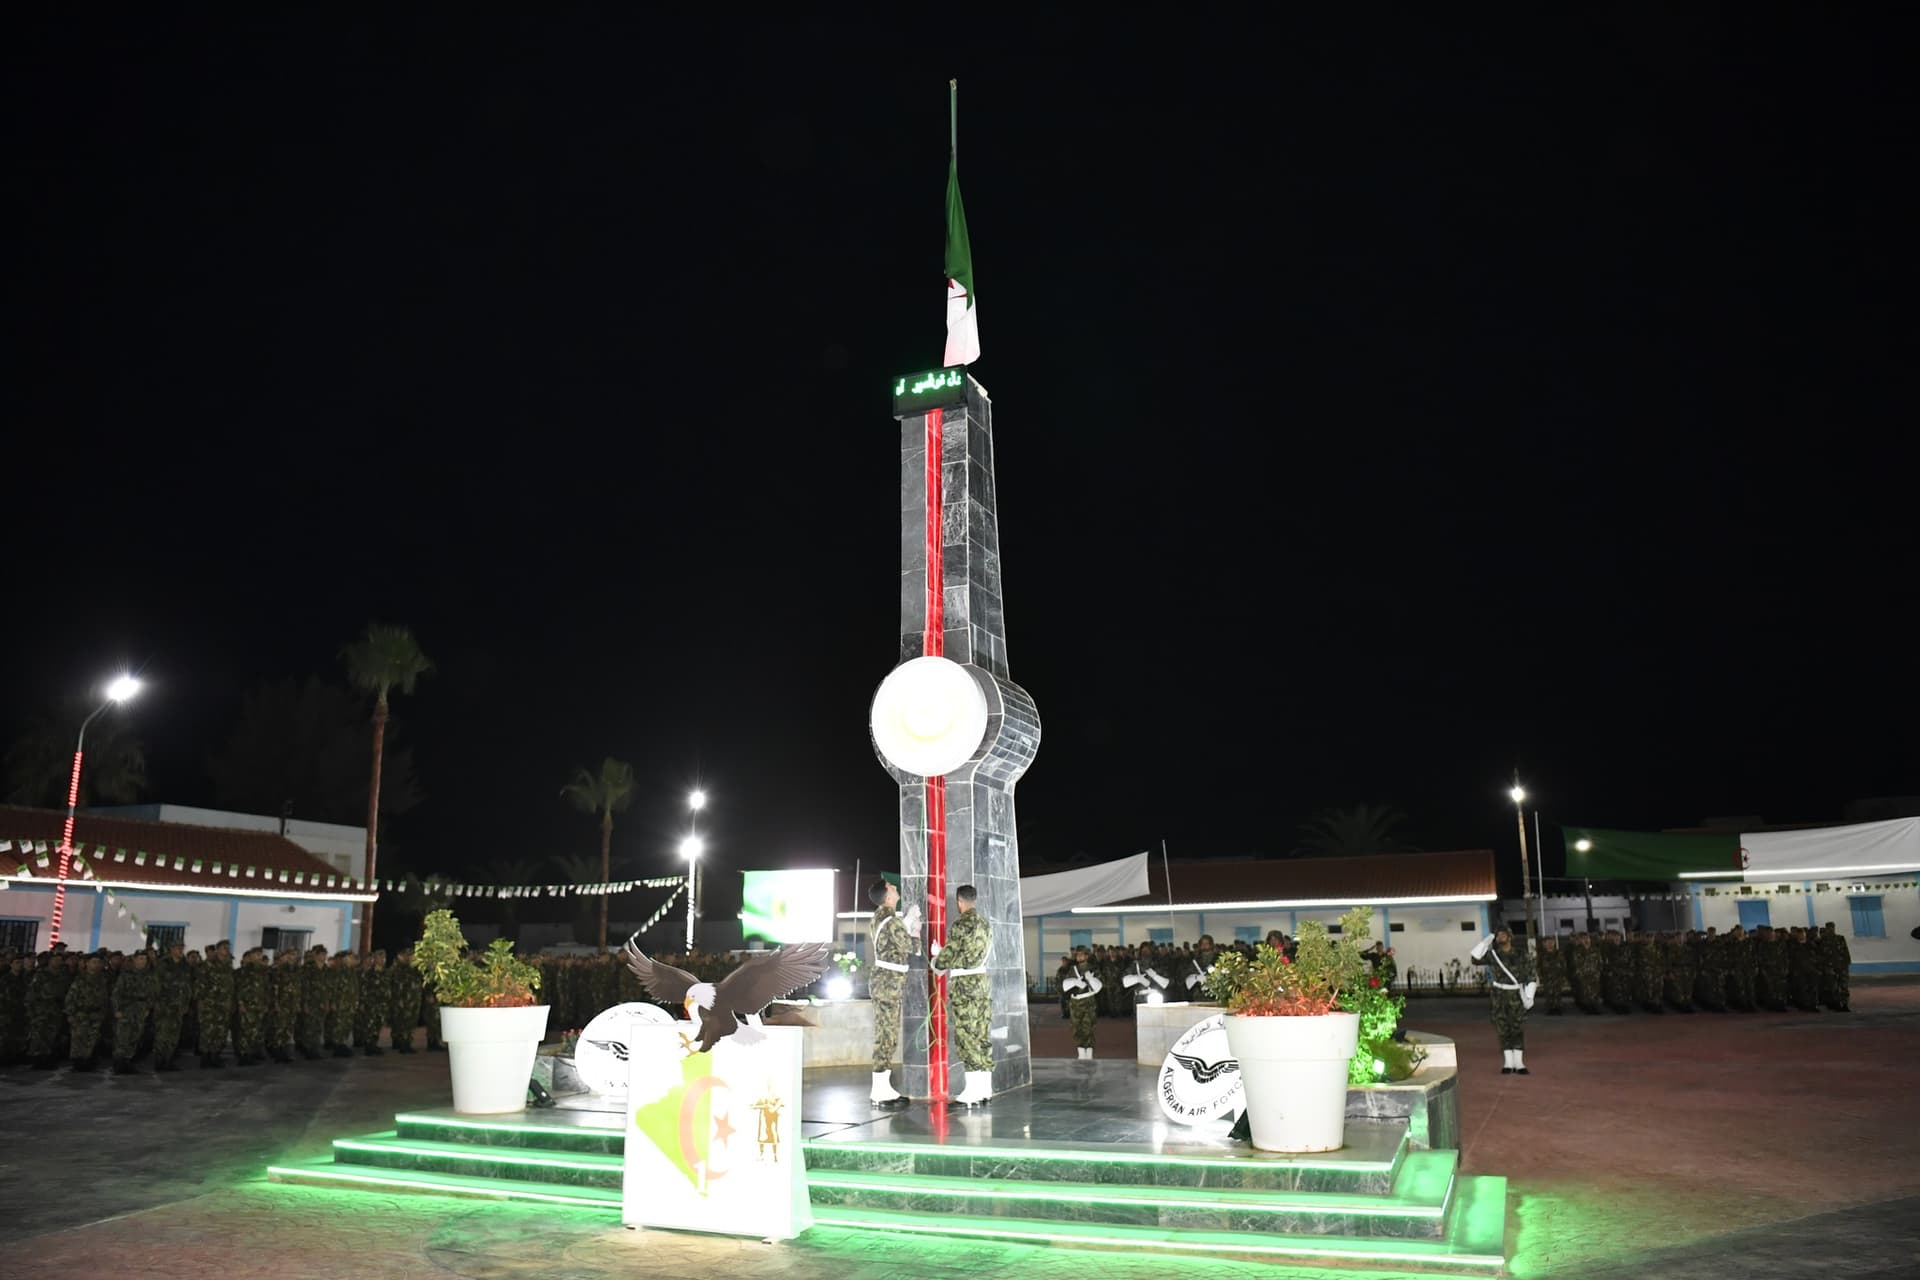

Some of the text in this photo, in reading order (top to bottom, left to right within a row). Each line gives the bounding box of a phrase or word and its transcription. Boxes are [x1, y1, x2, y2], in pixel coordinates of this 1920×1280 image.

[1162, 1066, 1243, 1117] ALGERIAN AIR FORC
